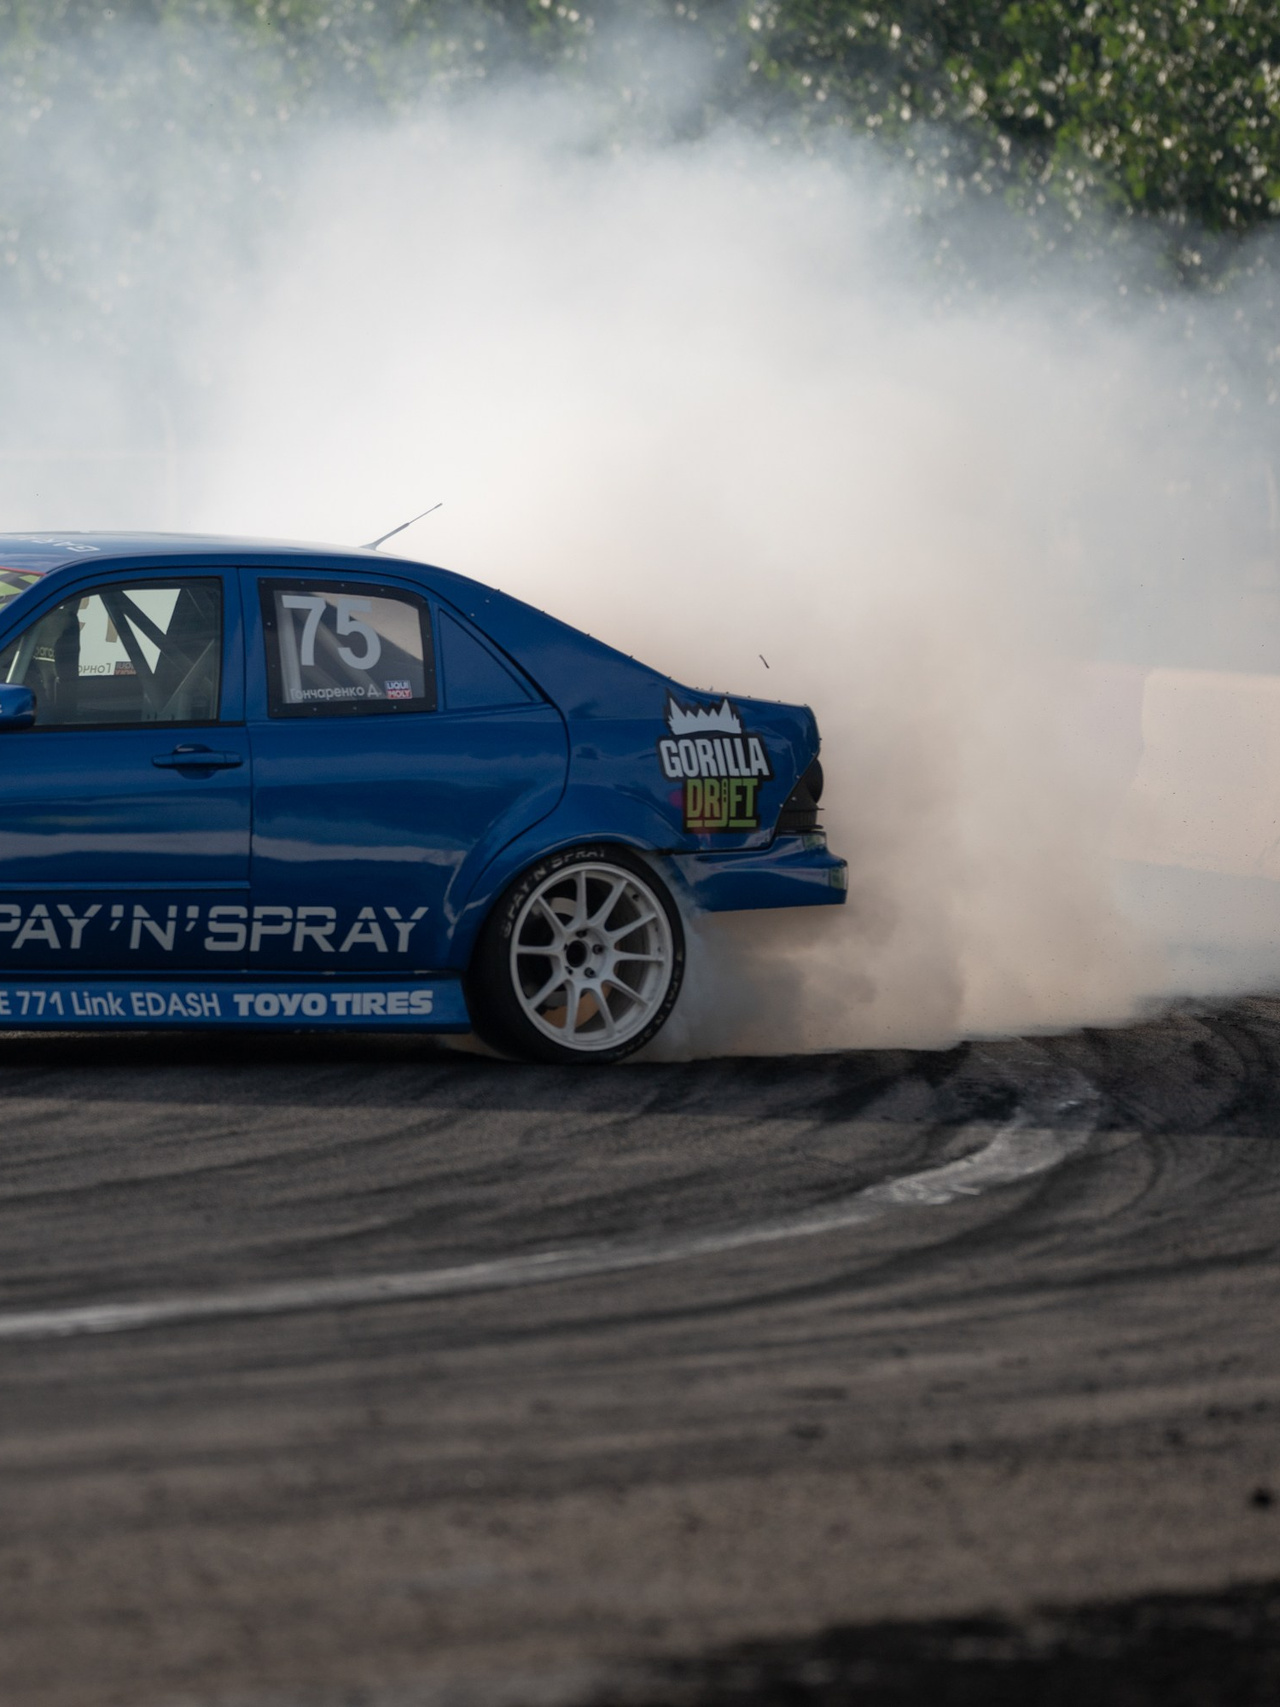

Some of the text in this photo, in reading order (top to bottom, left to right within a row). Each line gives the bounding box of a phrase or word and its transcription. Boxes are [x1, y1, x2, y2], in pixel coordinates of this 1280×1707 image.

[281, 594, 381, 670] 75
[290, 687, 365, 700] Гончаренко
[387, 690, 412, 699] MOLY
[659, 737, 770, 778] GORILLA
[686, 778, 758, 827] DRIFT
[16, 991, 64, 1015] 771
[71, 991, 126, 1016] Link
[131, 992, 221, 1017] EDASH
[233, 993, 328, 1017] TOYO
[330, 990, 434, 1016] TIRES
